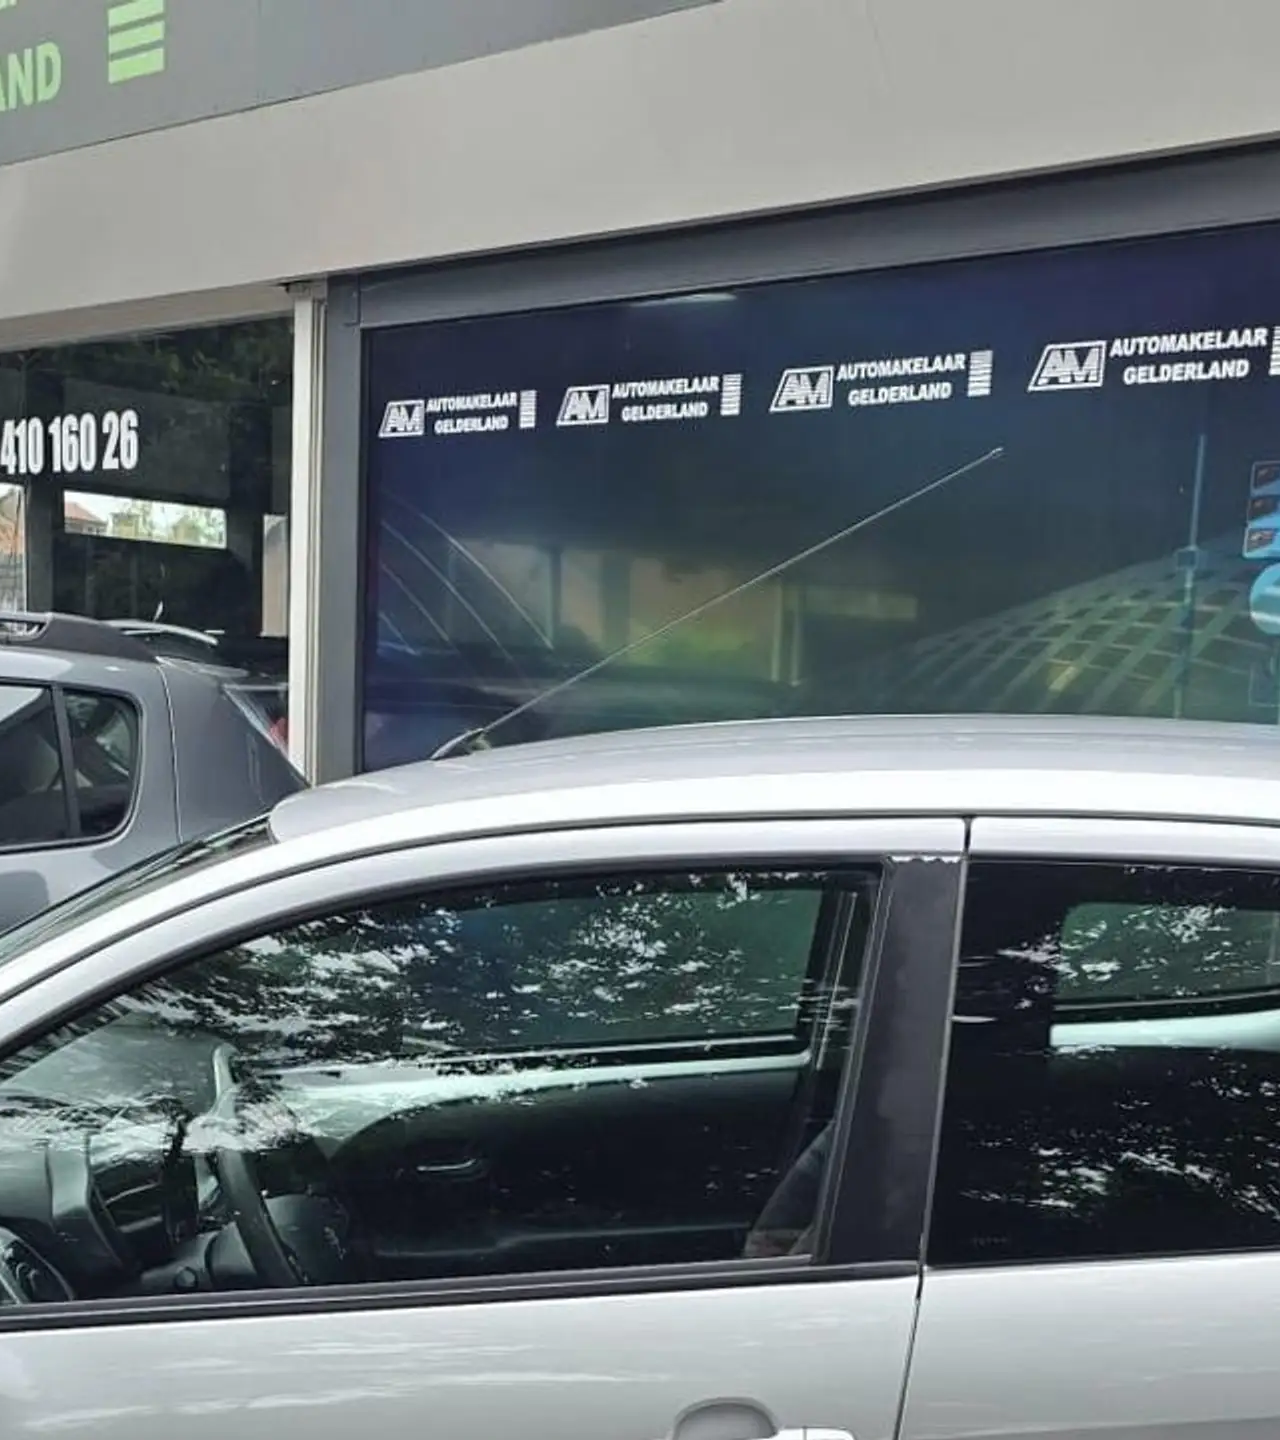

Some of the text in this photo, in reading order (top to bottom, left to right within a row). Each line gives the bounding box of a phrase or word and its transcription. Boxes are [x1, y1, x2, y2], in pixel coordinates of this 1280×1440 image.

[1110, 328, 1268, 357] AUTOMAKELAAR
[836, 353, 966, 381] AUTOMAKELAAR
[1123, 359, 1249, 385] GELDERLAND
[612, 376, 719, 399] AUTOMAKELAAR
[847, 382, 952, 406] GELDERLAND
[622, 402, 708, 421] GELDERLAND
[0, 417, 45, 475] 410
[48, 412, 97, 473] 160
[102, 409, 139, 471] 26
